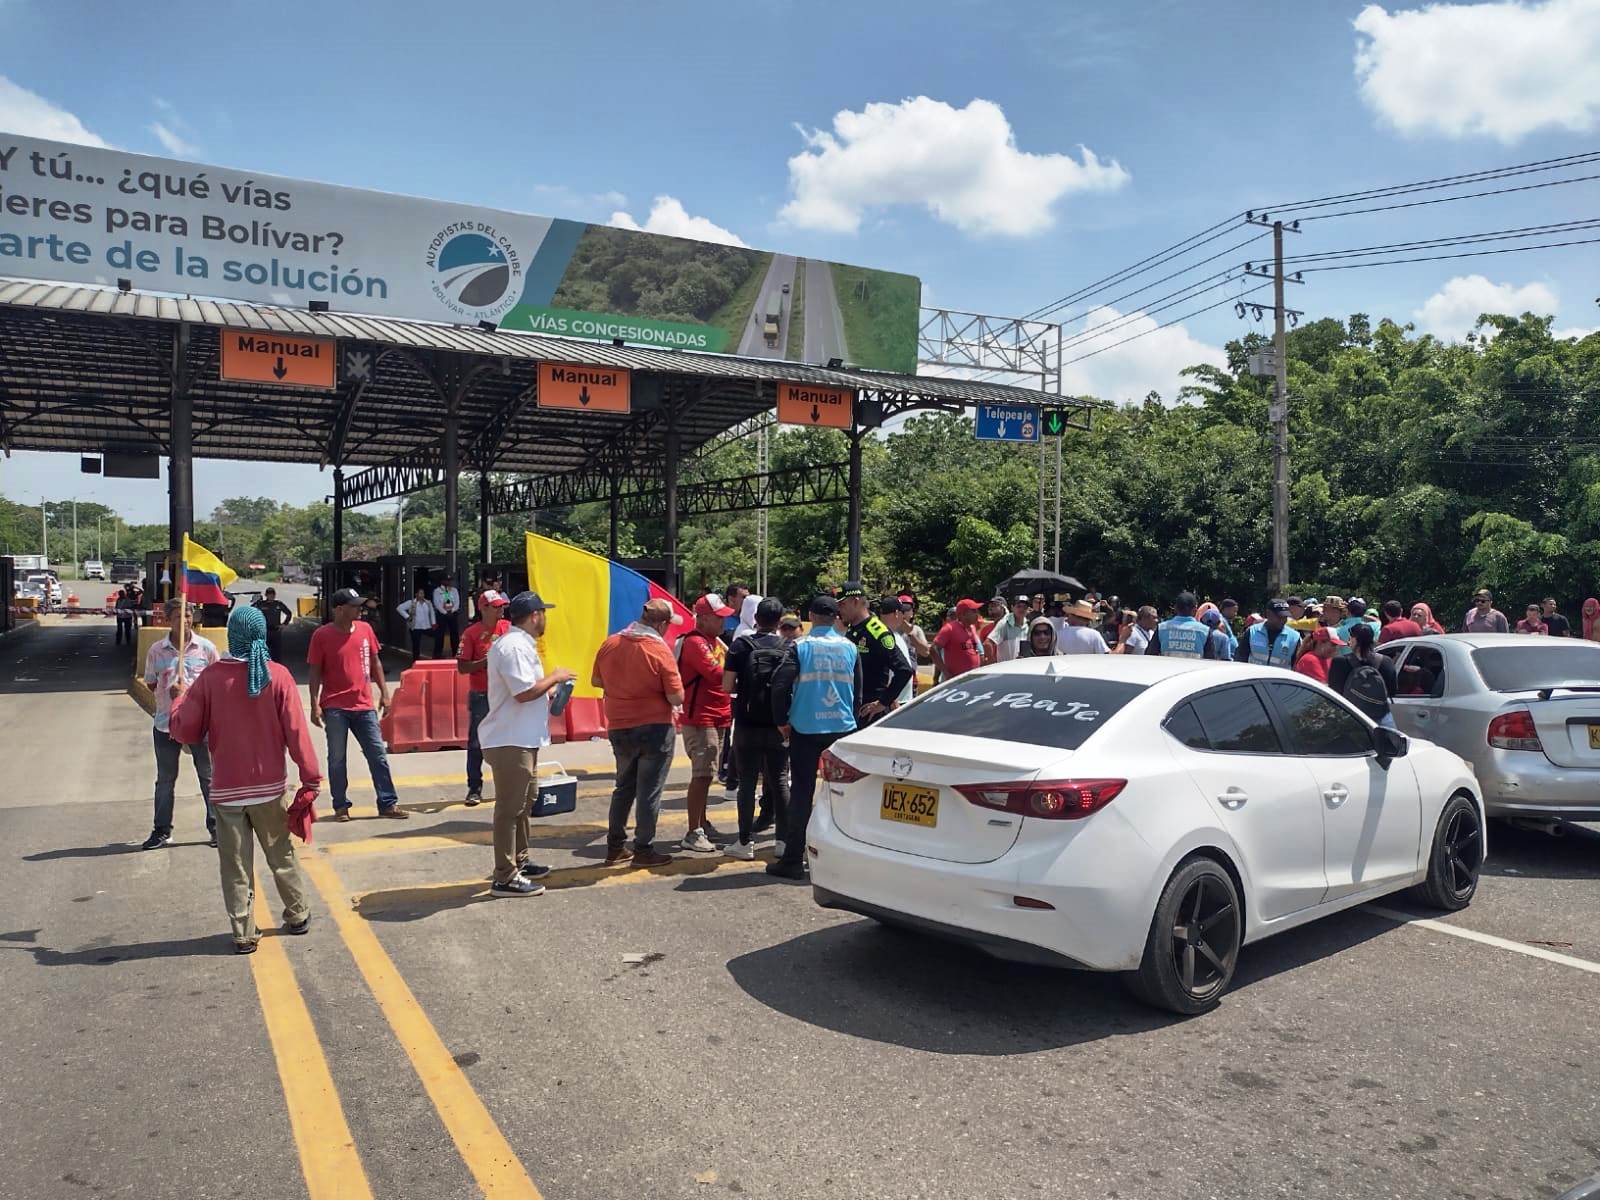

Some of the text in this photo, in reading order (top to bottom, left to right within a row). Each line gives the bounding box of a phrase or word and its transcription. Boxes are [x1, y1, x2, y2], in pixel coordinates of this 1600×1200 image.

[30, 151, 104, 185] tú...
[118, 168, 210, 200] ¿qué
[221, 180, 291, 211] vías
[106, 207, 188, 237] para
[202, 215, 344, 256] Bolívar?
[426, 221, 521, 277] AUTOPISTAS DEL CARIBE
[106, 240, 160, 272] de
[175, 247, 209, 279] la
[223, 258, 388, 298] solución
[238, 335, 320, 358] Manual
[529, 313, 707, 347] VÍAS CONCESIONADAS
[551, 368, 617, 386] Manual
[788, 388, 843, 405] Manual
[984, 406, 1033, 423] Telepeaje
